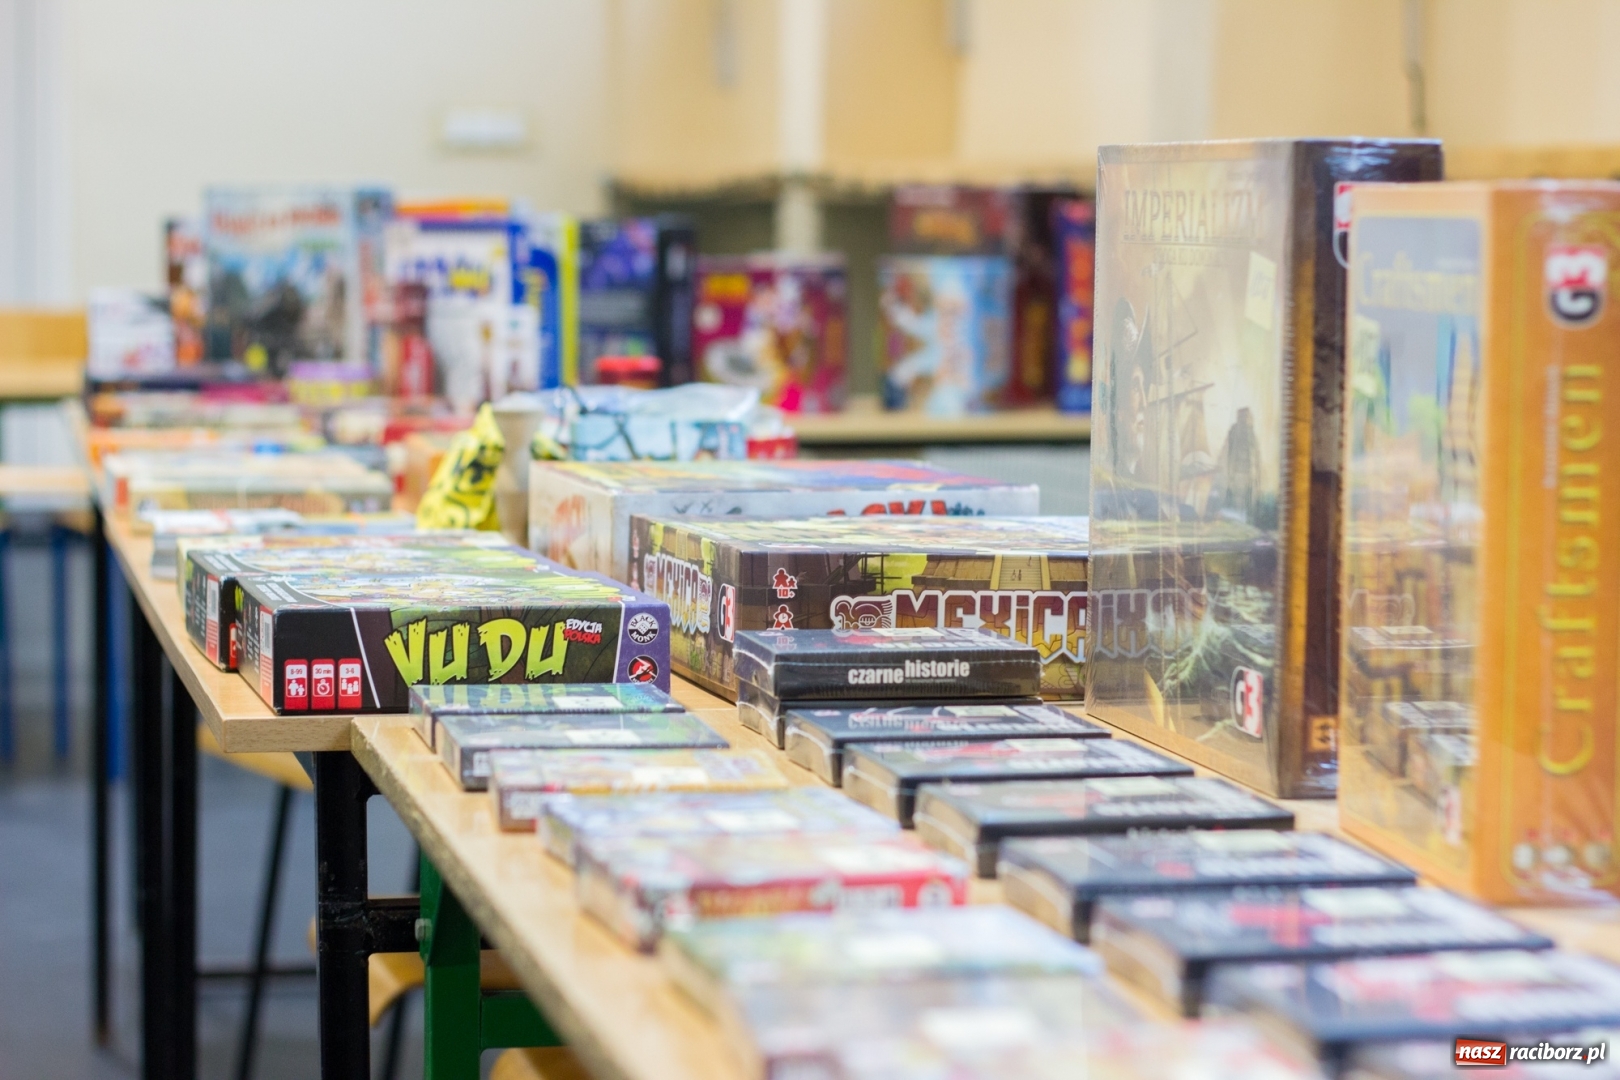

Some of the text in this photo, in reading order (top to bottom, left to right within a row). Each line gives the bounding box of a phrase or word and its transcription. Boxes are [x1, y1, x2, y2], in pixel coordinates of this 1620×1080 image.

[565, 618, 603, 634] EDYCJA
[630, 614, 657, 627] BLACK
[563, 629, 602, 645] POLSKA
[630, 630, 657, 644] MONK
[848, 659, 970, 684] czarne historie
